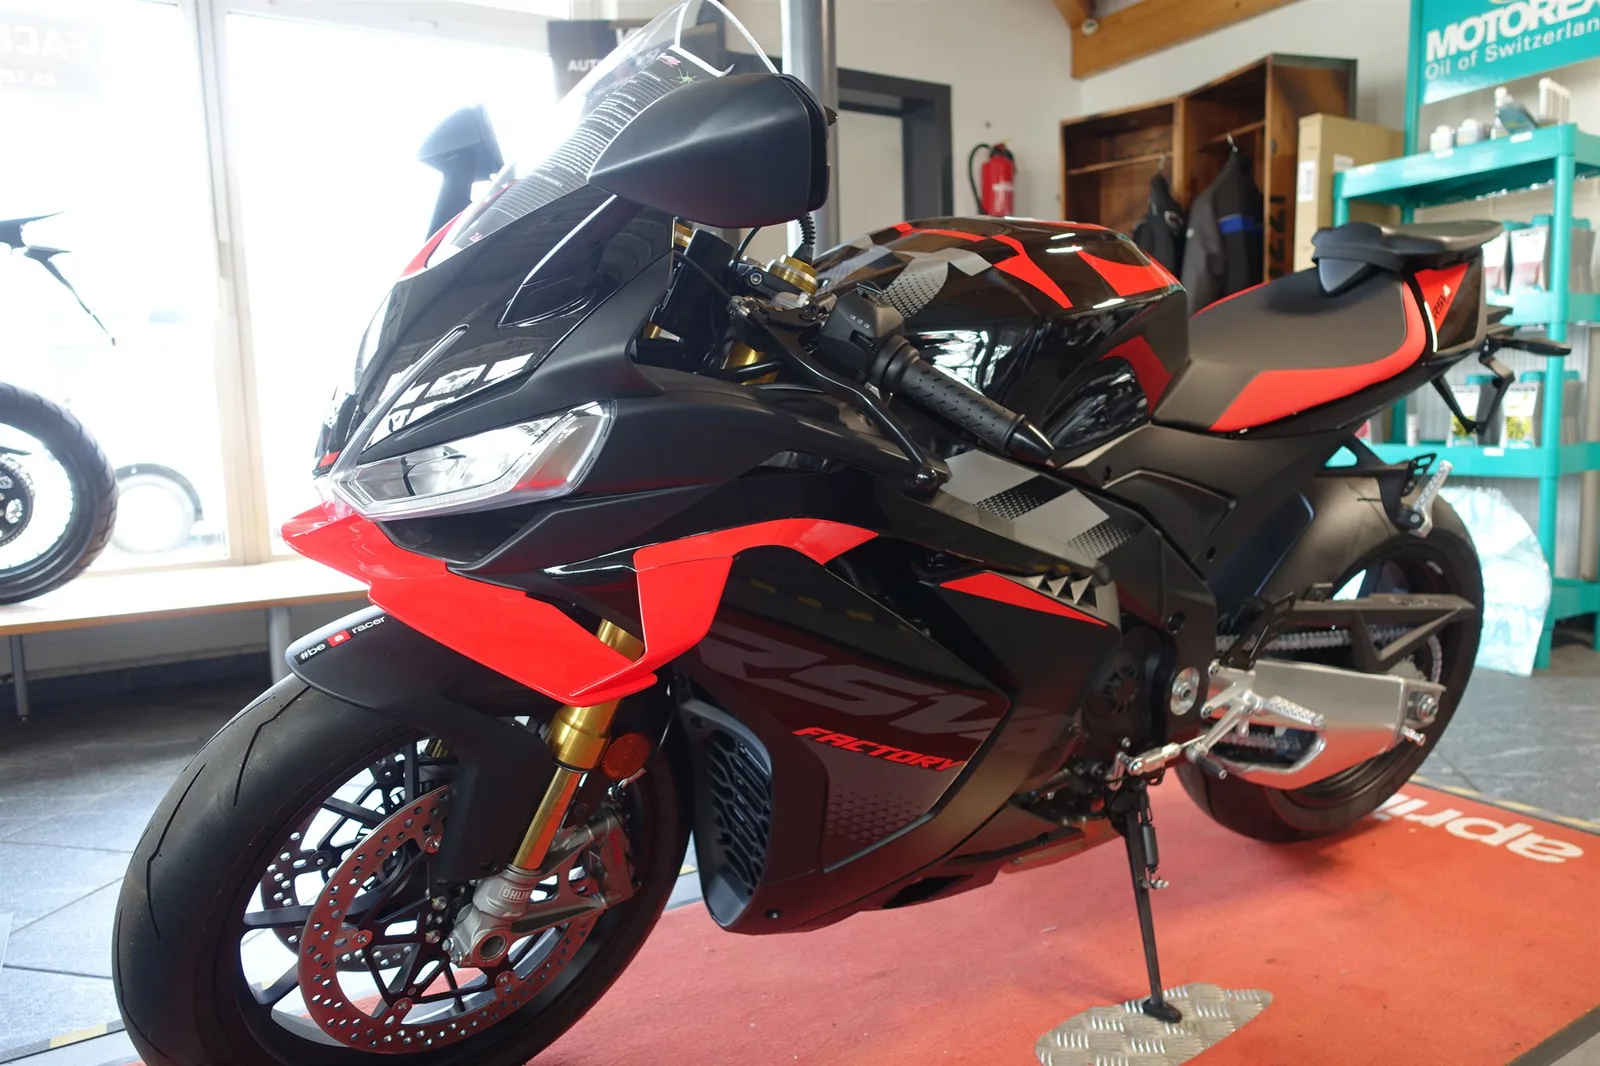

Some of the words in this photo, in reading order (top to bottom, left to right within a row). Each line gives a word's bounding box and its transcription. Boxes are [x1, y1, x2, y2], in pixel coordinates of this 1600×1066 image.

[1425, 61, 1451, 81] Oil
[1458, 48, 1478, 71] of
[300, 643, 326, 660] #be
[352, 616, 386, 634] racer
[793, 726, 967, 772] FACTORY
